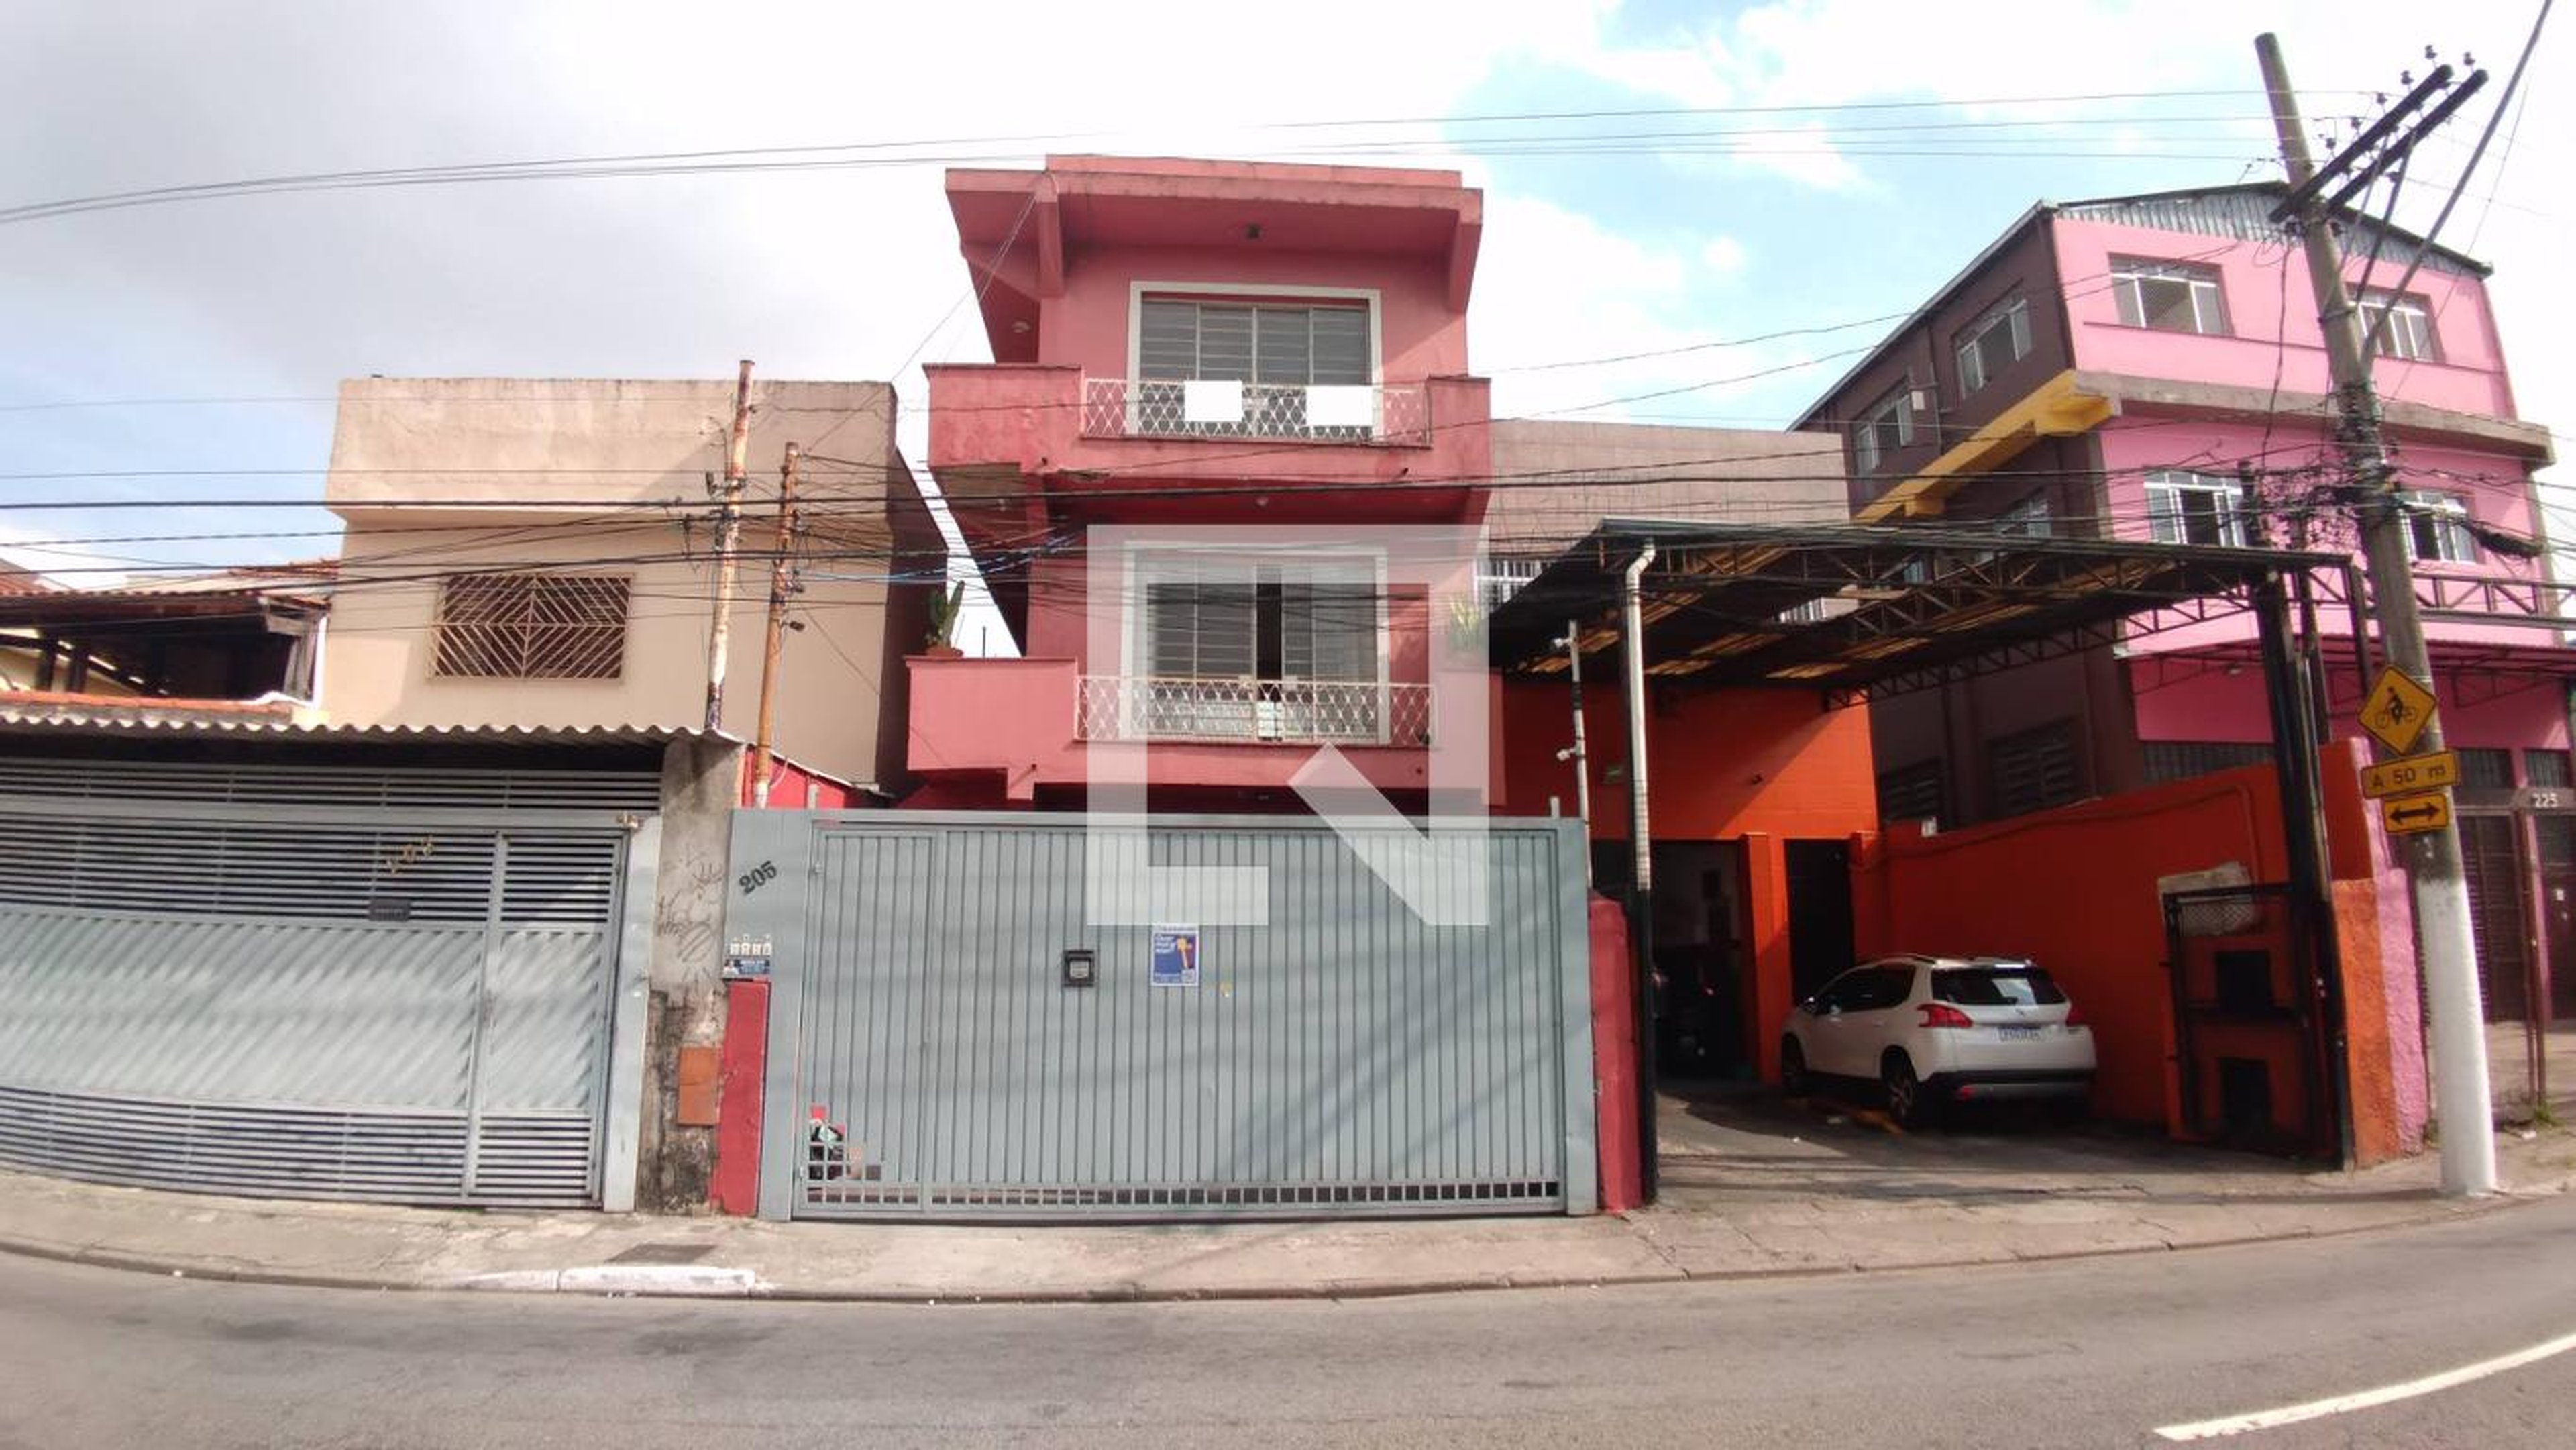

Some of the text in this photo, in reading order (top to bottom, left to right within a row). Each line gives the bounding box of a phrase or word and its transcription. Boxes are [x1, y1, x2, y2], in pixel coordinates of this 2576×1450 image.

[2370, 764, 2447, 788] A 50 m
[2532, 792, 2558, 809] 225
[739, 860, 777, 895] 205
